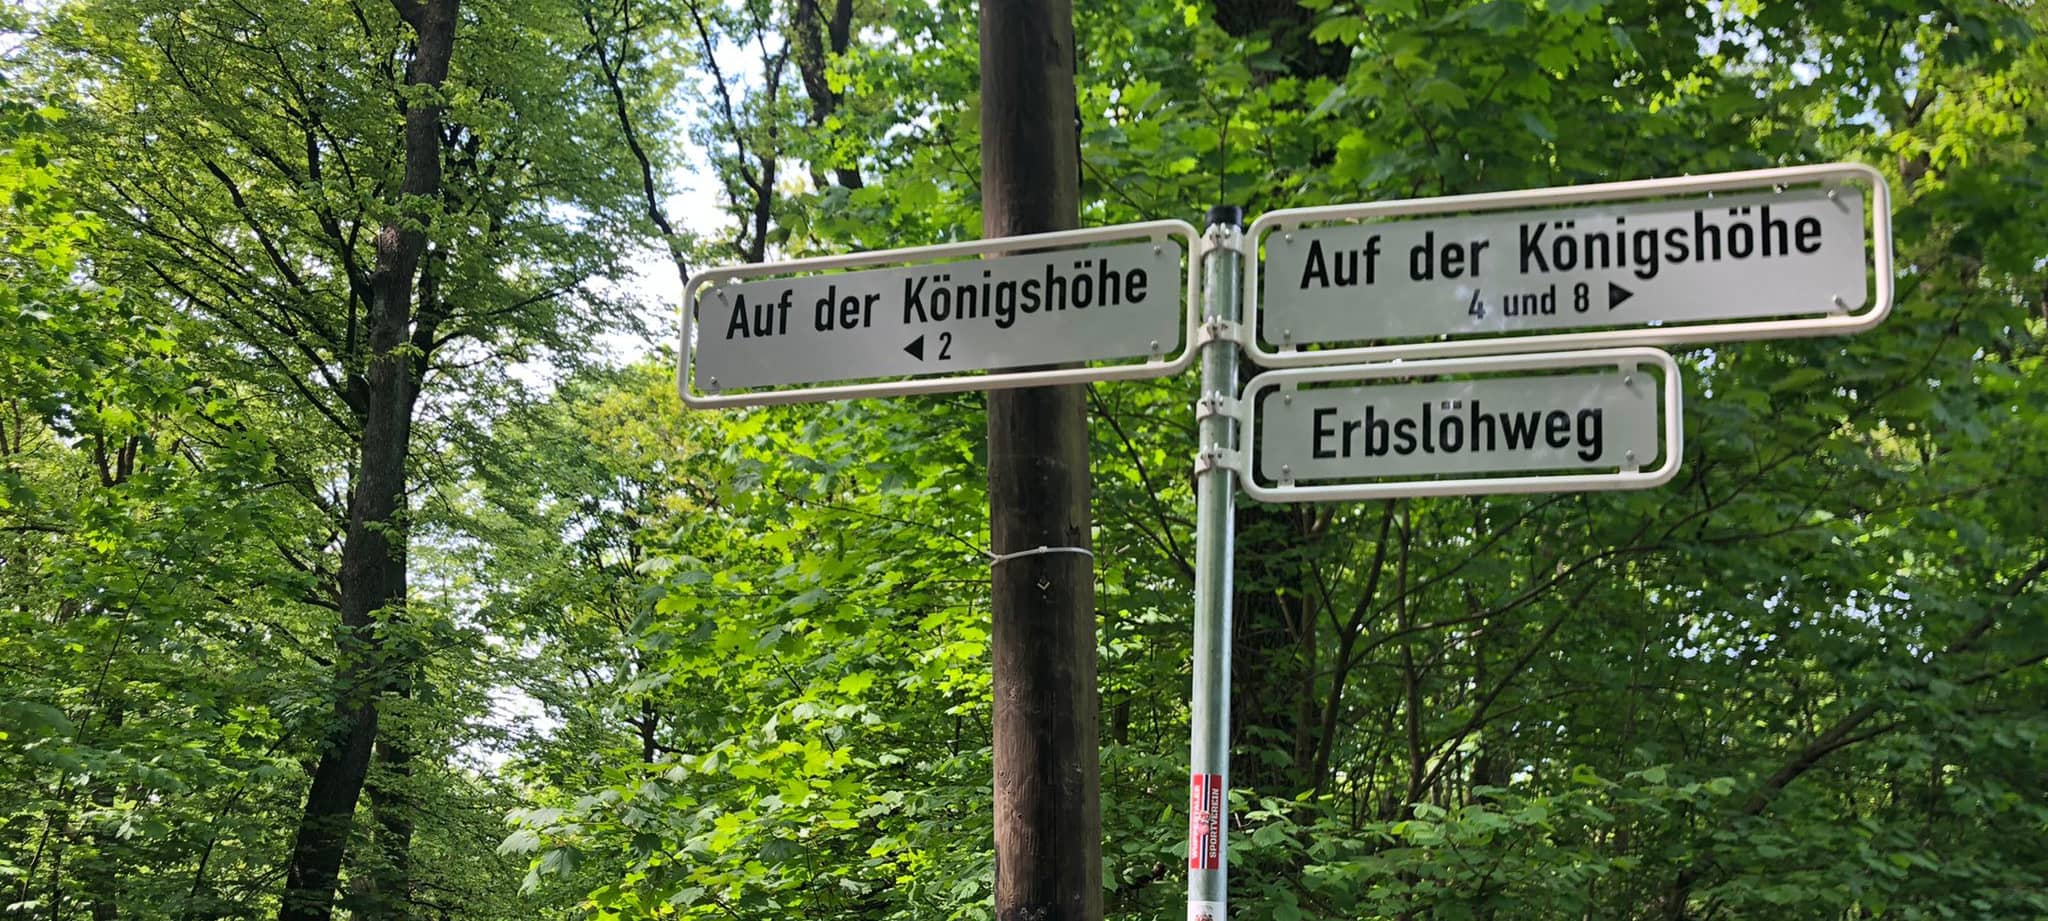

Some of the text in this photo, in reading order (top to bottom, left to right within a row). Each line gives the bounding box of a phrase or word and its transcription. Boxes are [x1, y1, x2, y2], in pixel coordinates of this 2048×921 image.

[1300, 205, 1823, 290] Auf der Königshöhe
[726, 259, 1148, 340] Auf der Königshöhe
[1468, 281, 1590, 320] 4 und 8
[938, 332, 952, 361] 2
[1312, 399, 1603, 461] Erbslöhweg
[1209, 788, 1219, 858] SPORTVEREIN
